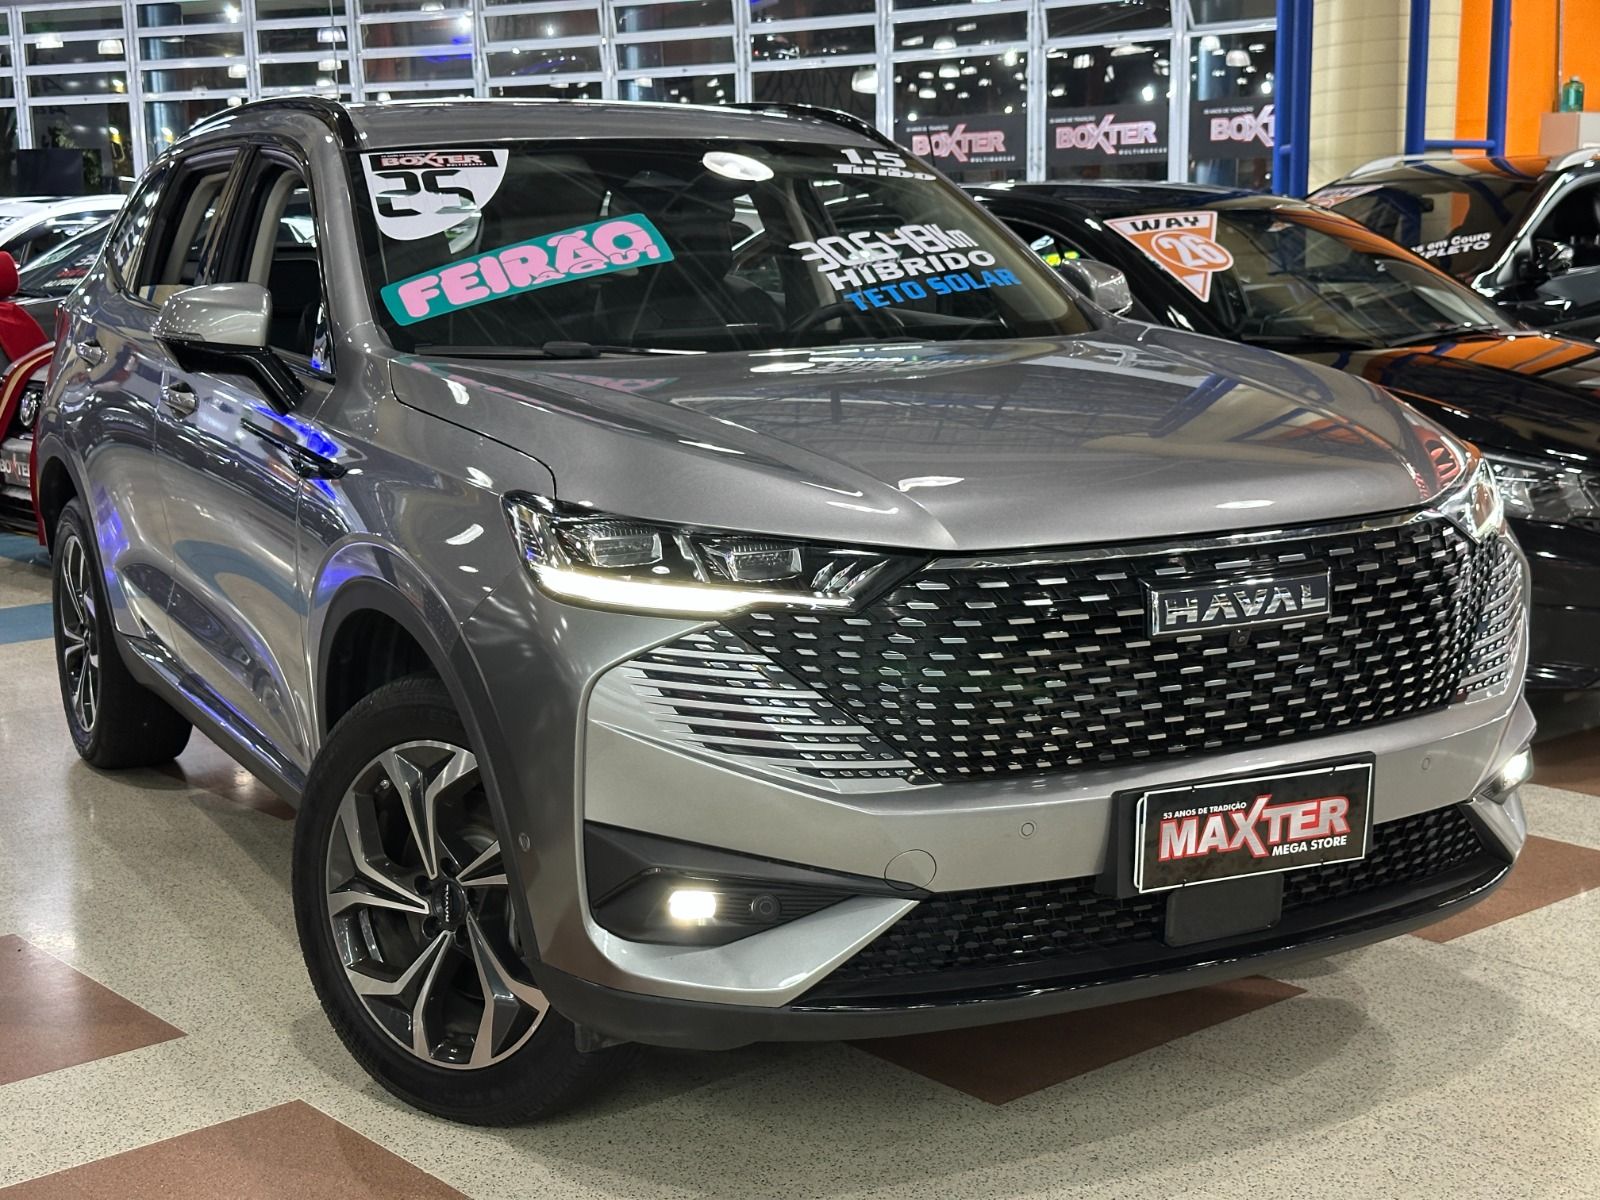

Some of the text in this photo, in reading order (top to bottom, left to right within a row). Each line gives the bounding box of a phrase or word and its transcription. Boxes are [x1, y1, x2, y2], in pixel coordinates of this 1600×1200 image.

[1055, 113, 1158, 154] BOXTER
[1210, 104, 1276, 147] BOXT
[840, 148, 907, 168] 1.5
[911, 123, 1007, 162] BOXTER
[380, 152, 483, 167] BOXTER
[832, 163, 937, 181] Turbo
[375, 169, 478, 218] 25
[1130, 216, 1200, 232] WAY
[1157, 235, 1225, 267] 26
[1420, 240, 1491, 260] PLETO
[1426, 239, 1449, 250] em
[1450, 231, 1492, 245] Couro
[397, 221, 653, 319] FEIRÃO
[843, 267, 1022, 312] TETO SOLAR
[1164, 583, 1327, 626] HAVAL
[1162, 801, 1247, 819] 53 ANOS DE TRADIÇÃO
[1158, 794, 1351, 862] MAXTER
[1271, 834, 1348, 857] MEGA STORE
